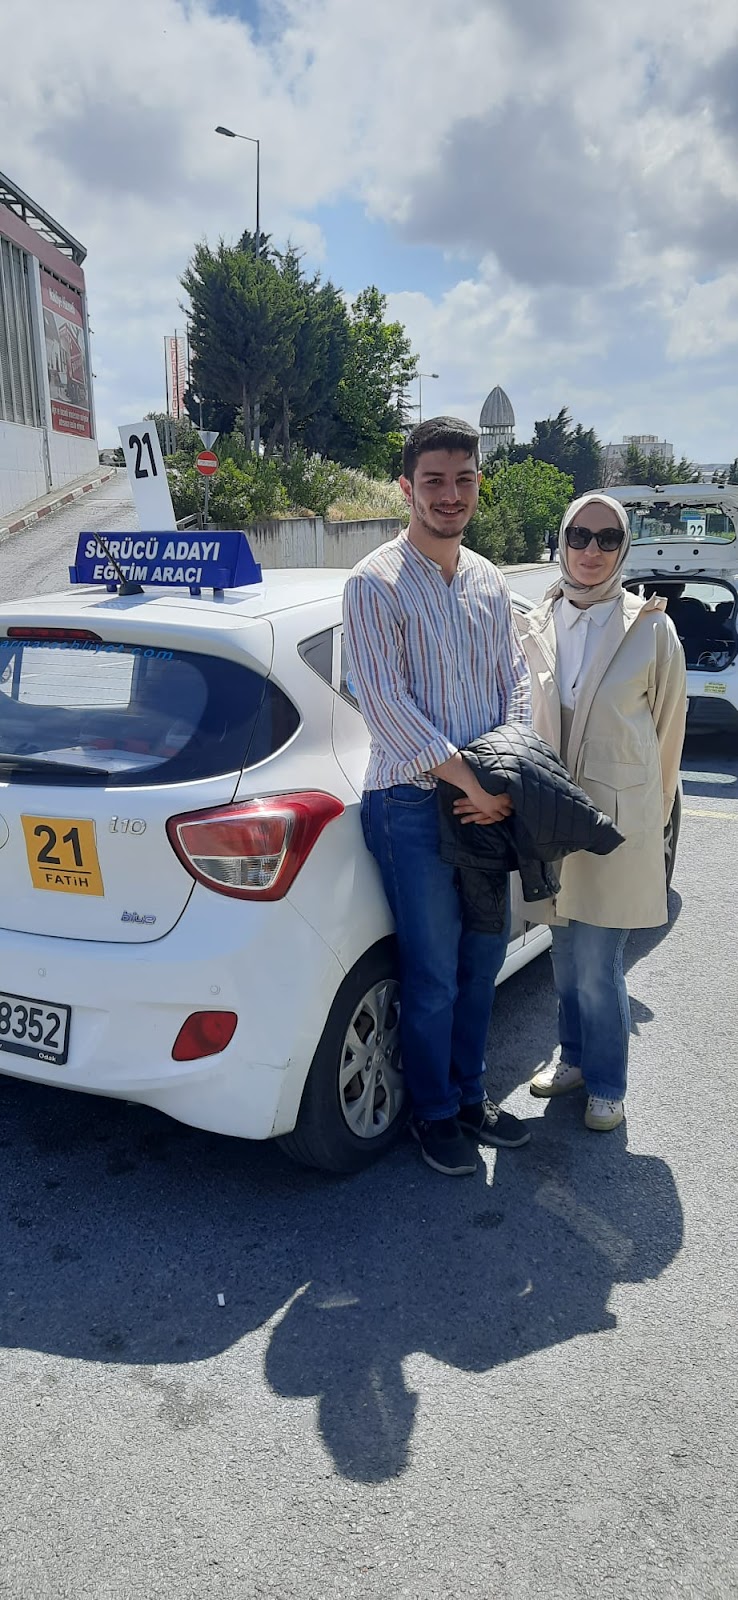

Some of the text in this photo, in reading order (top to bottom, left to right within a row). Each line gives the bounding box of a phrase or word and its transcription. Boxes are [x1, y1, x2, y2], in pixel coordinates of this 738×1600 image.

[129, 432, 158, 479] 21
[84, 536, 220, 561] SÜRÜCÜ ADAYI
[151, 566, 202, 583] ARACI
[109, 815, 147, 836] i10
[33, 825, 84, 867] 21
[0, 1001, 61, 1049] 8352
